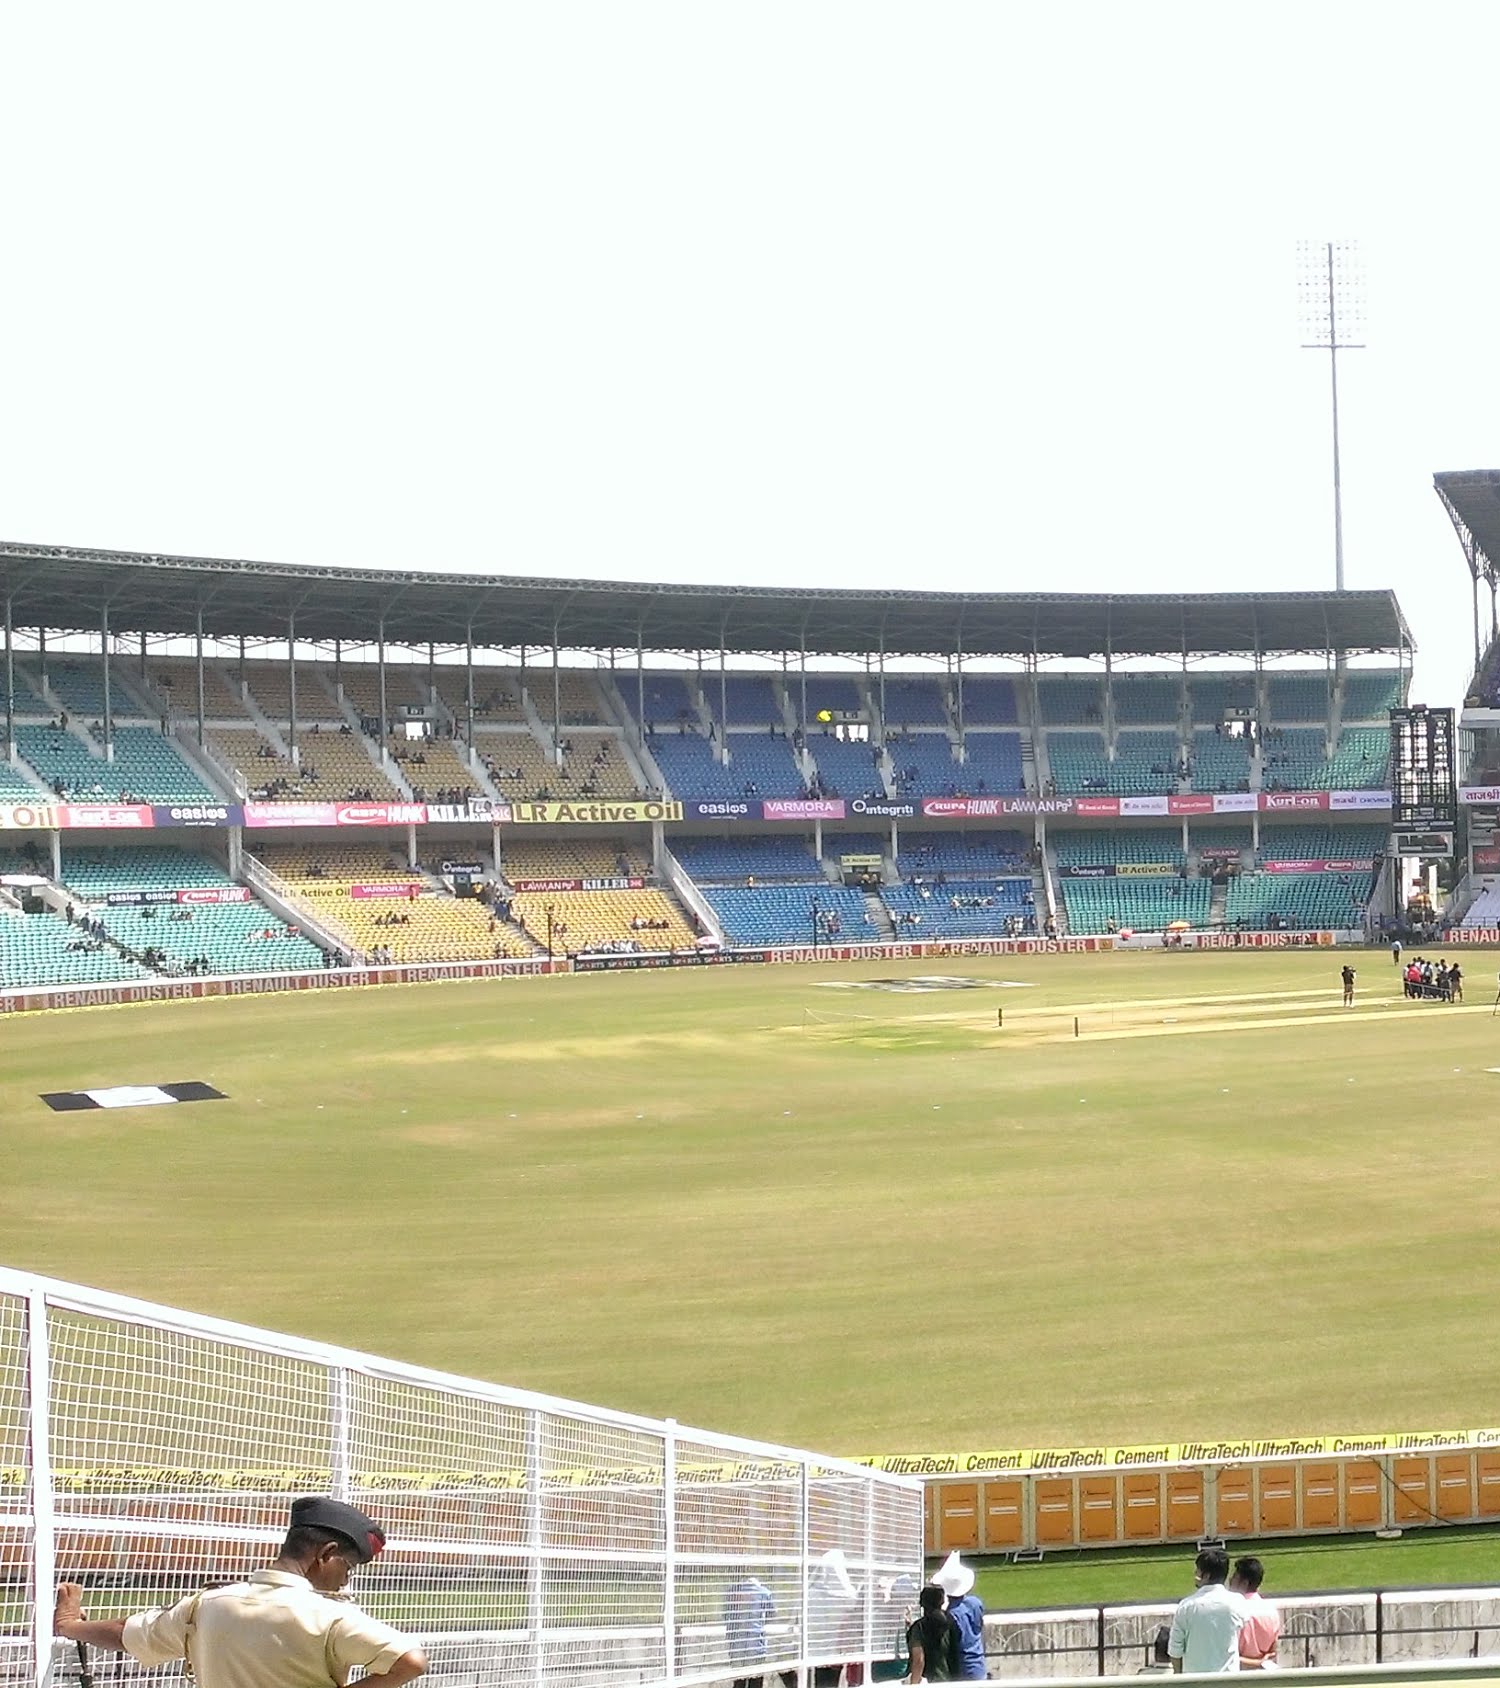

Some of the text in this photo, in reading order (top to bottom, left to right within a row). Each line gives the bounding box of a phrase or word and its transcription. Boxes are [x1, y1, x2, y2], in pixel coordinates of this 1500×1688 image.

[767, 801, 834, 813] VARMORA
[935, 799, 1000, 815] RUPA HUNK
[1266, 794, 1319, 808] Kurl-on
[13, 807, 53, 826] Oil
[514, 801, 680, 821] LR Active Oil
[301, 886, 352, 898] Active Oil
[582, 879, 629, 890] KILLER
[770, 945, 913, 965] RENAULT DUSTER
[409, 962, 542, 983] RENAULT DUSTER
[234, 971, 370, 994] RENAULT DUSTER
[54, 983, 193, 1009] RENAULT DUSTER
[1256, 1437, 1387, 1456] UltraTech Cement
[1400, 1433, 1465, 1449] UltraTech
[1034, 1447, 1169, 1468] UltraTech Cement
[1182, 1443, 1251, 1461] UltraTech
[884, 1453, 1022, 1474] UltraTech Cement
